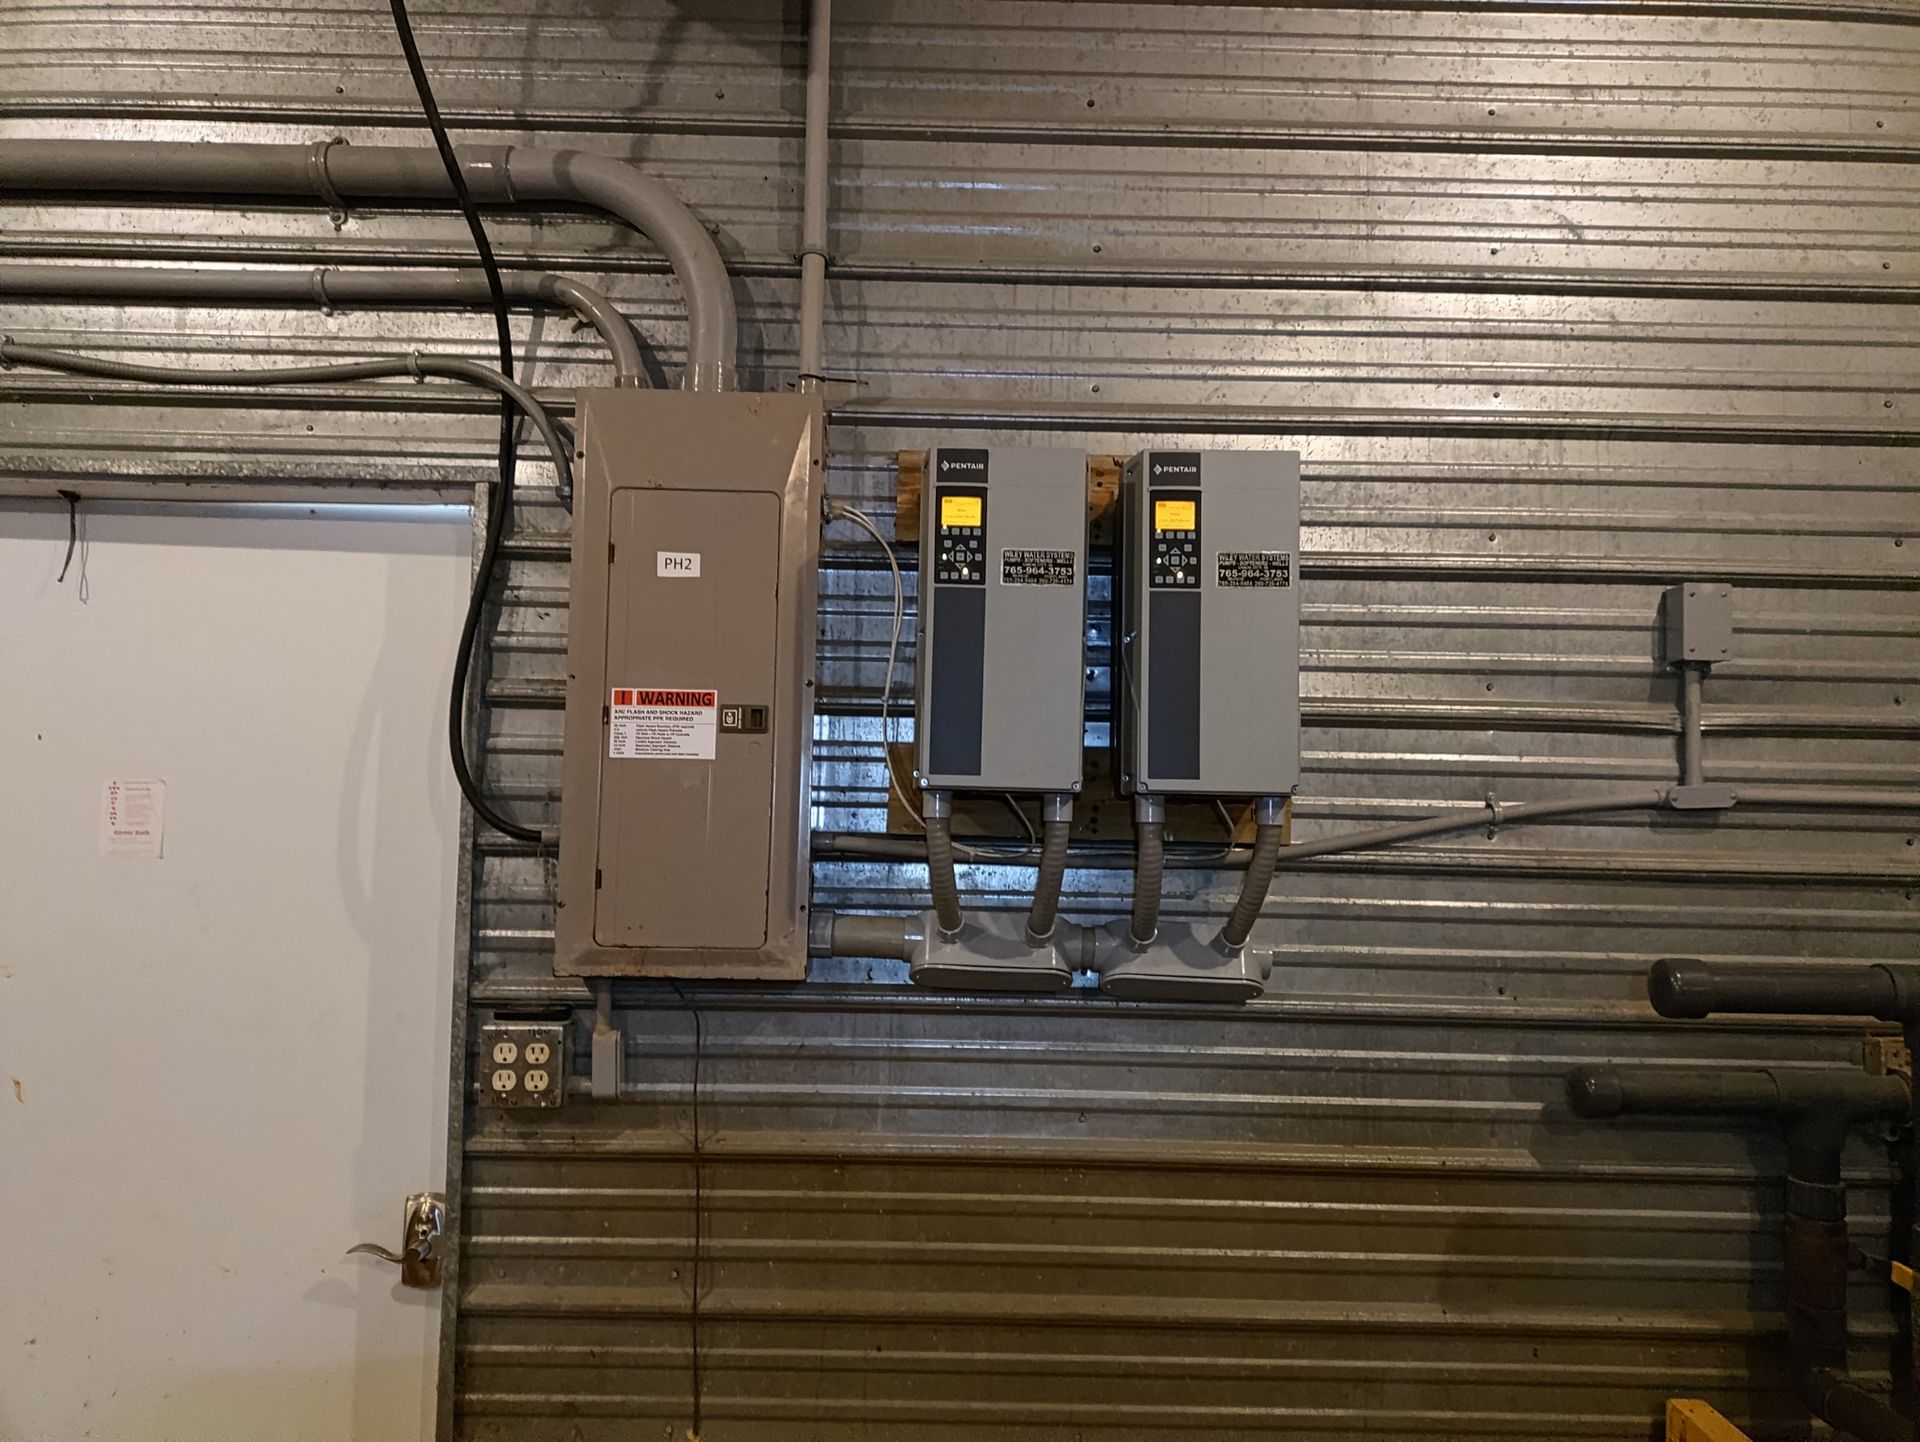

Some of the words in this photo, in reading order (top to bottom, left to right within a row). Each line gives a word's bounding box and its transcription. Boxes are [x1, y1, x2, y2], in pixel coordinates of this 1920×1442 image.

[951, 462, 984, 471] PENTAIR
[1163, 465, 1197, 474] PENTAIR
[1046, 551, 1074, 559] SYSTEMS
[1219, 553, 1237, 561] WILEY
[665, 557, 692, 570] PH2
[1004, 566, 1073, 575] 765-964-3753
[1219, 569, 1288, 578] 765-964-3753
[640, 692, 713, 706] WARNING
